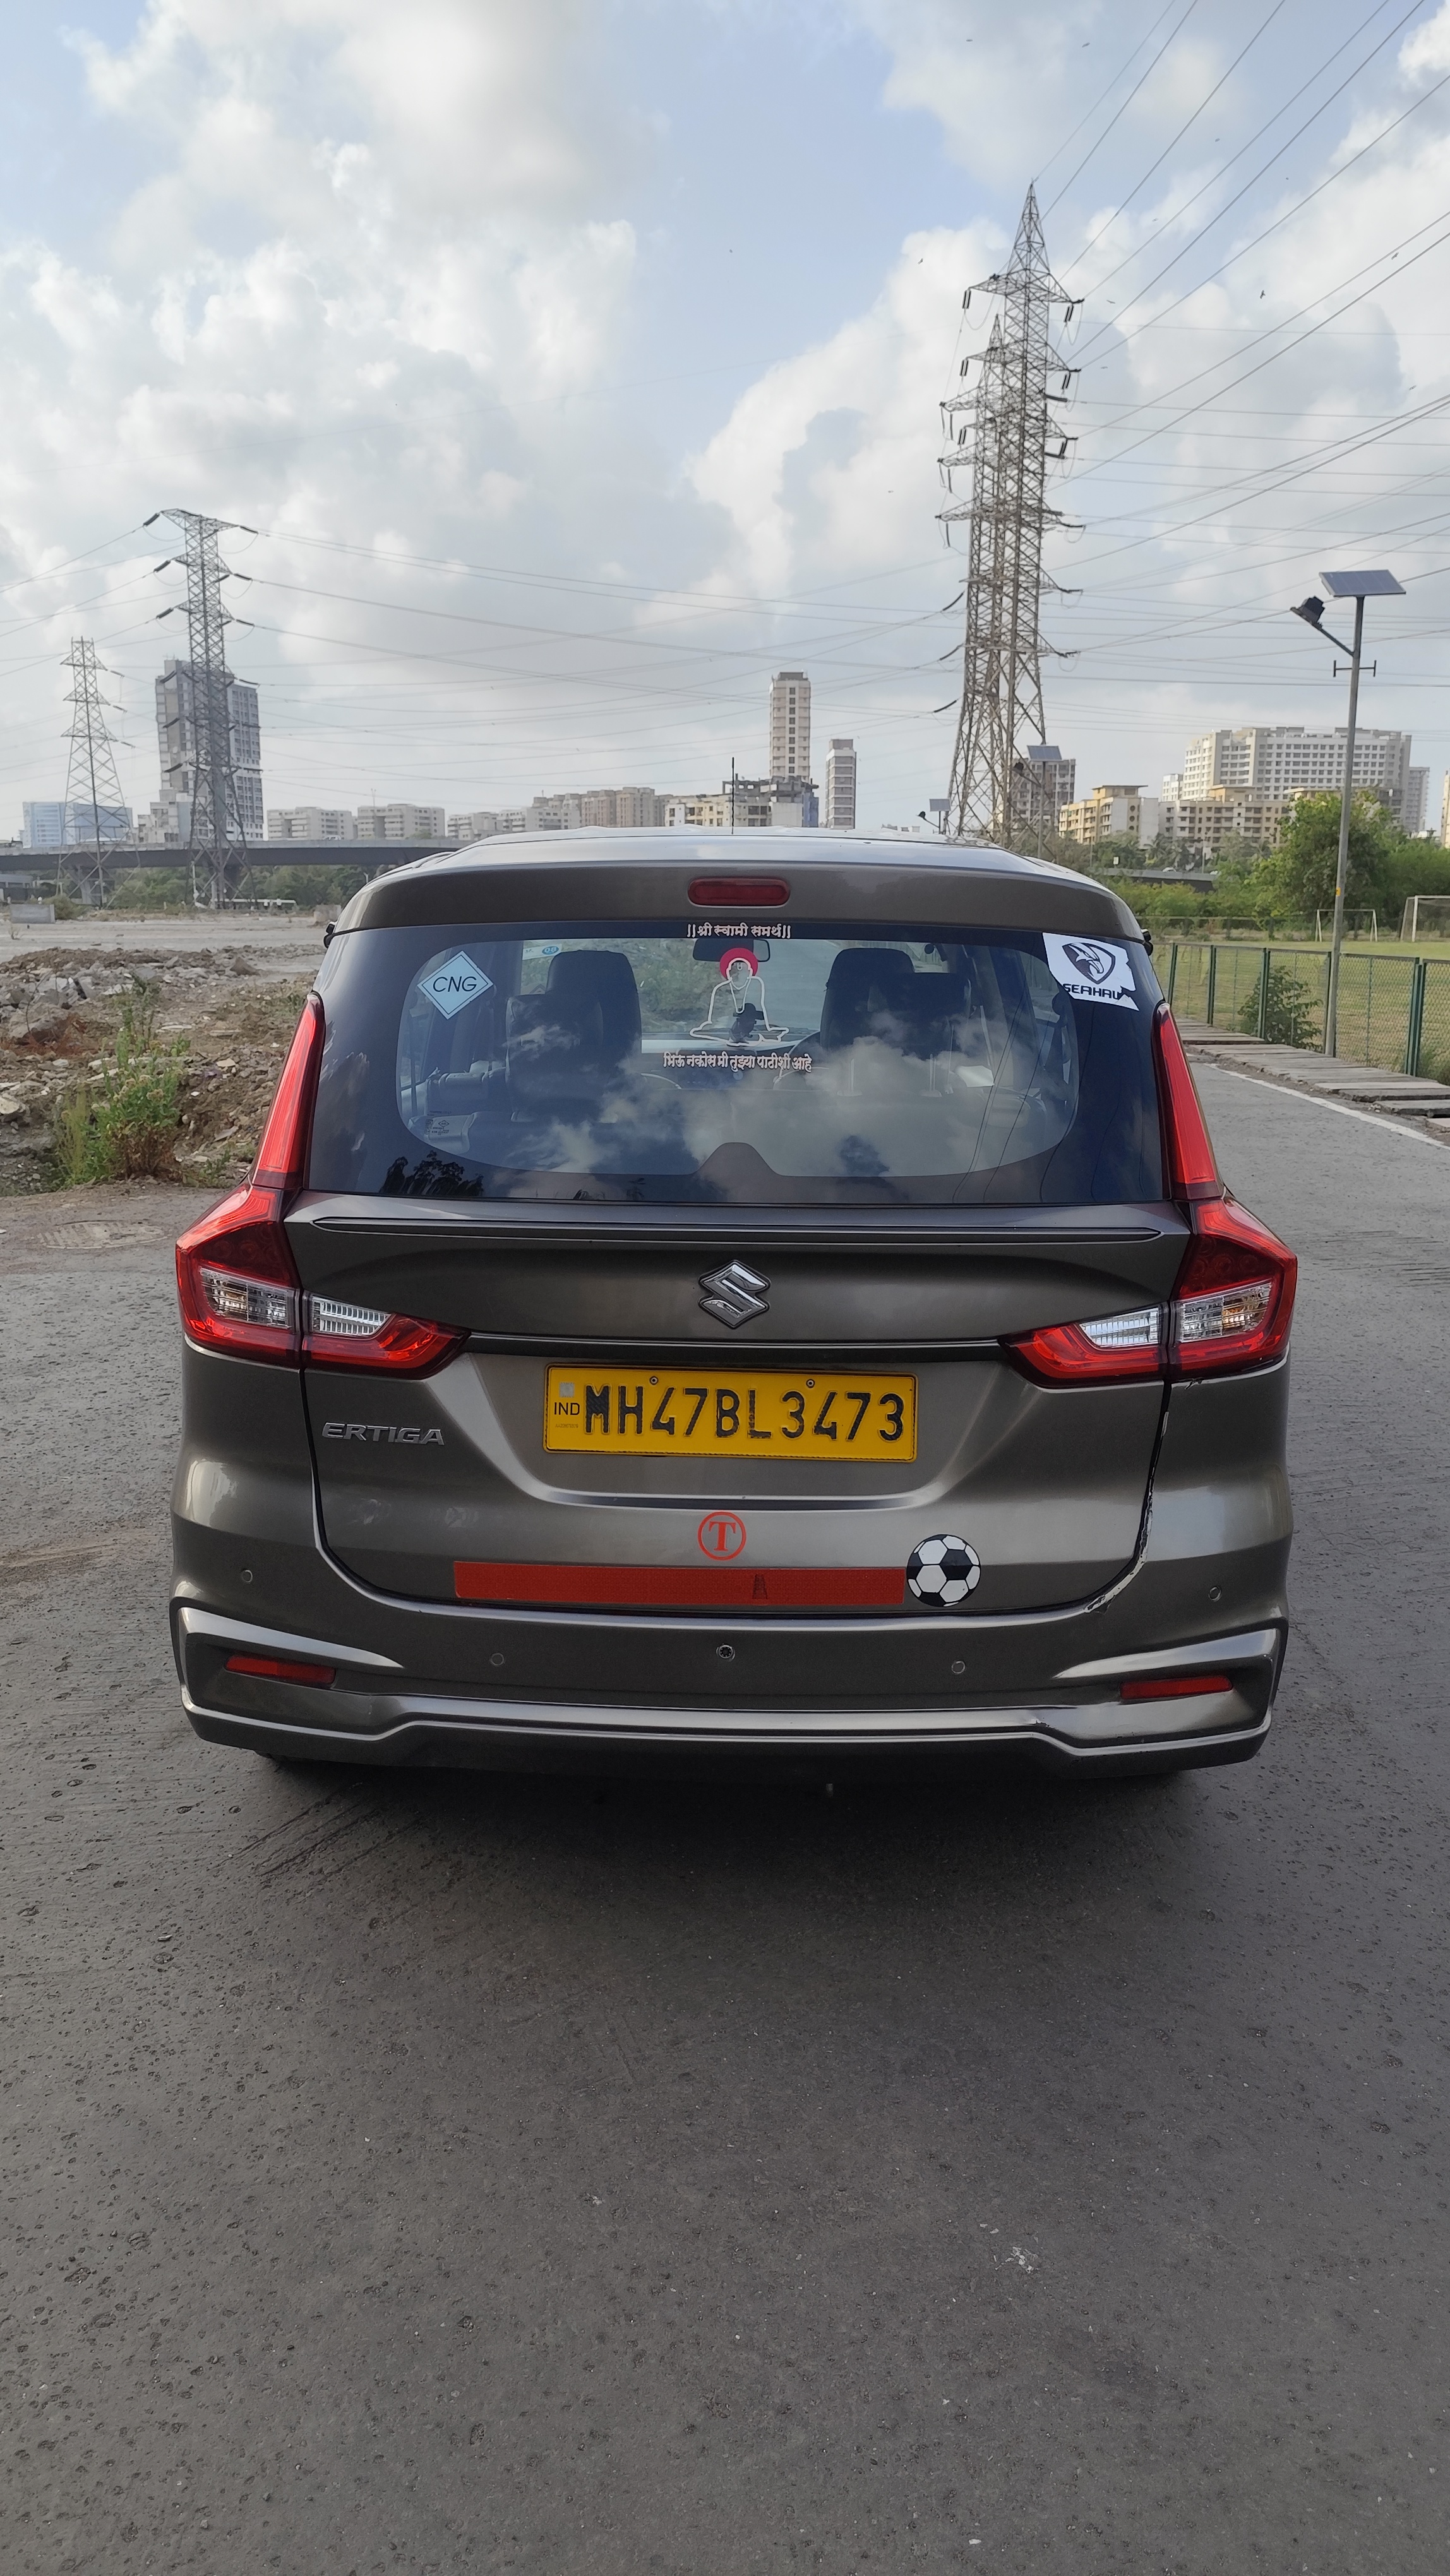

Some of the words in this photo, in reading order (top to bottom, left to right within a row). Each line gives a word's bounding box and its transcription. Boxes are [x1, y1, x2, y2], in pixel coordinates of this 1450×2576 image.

[714, 922, 748, 937] स्वामी
[433, 976, 477, 992] CNG
[663, 1051, 685, 1068] भिऊ
[686, 1051, 717, 1068] नकोस
[717, 1051, 728, 1068] मी
[757, 1052, 791, 1070] पाठीशी
[791, 1053, 813, 1072] आहे
[554, 1402, 580, 1416] IND
[584, 1385, 905, 1442] MH47BL3473
[321, 1422, 445, 1446] ERTIGA
[708, 1520, 736, 1552] T
